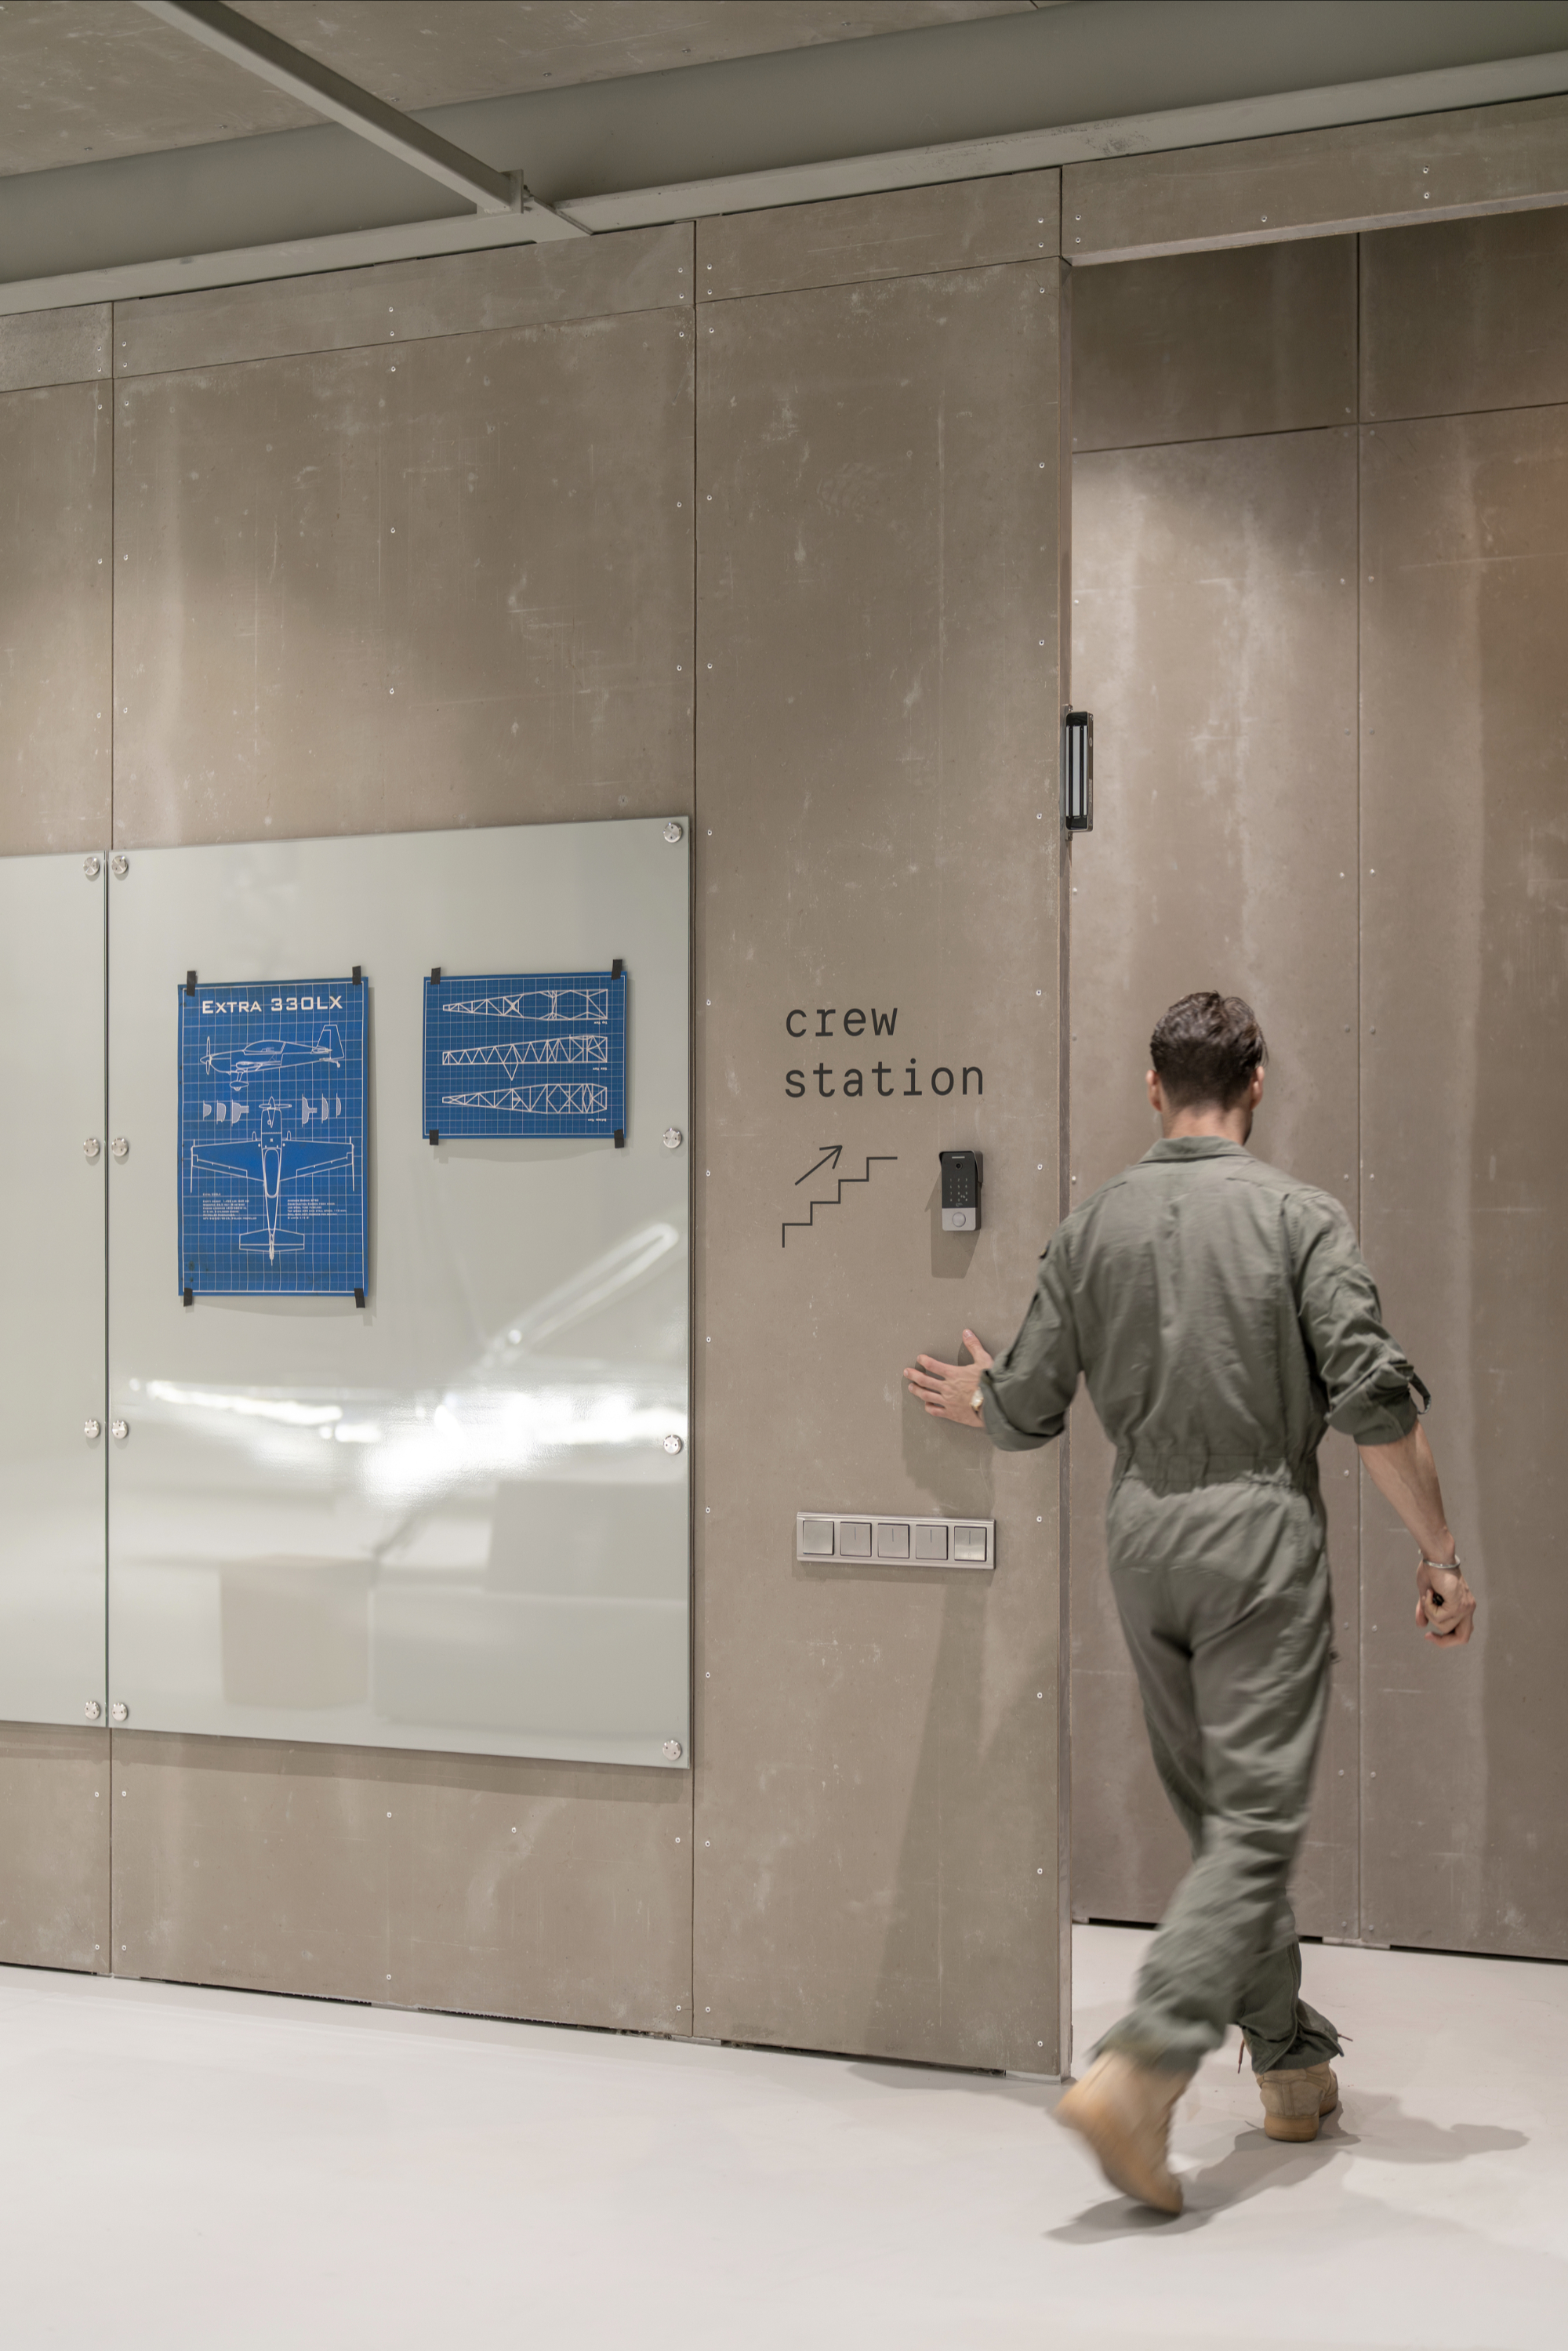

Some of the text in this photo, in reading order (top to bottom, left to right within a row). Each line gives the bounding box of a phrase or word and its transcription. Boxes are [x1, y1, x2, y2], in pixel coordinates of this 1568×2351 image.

[270, 995, 343, 1011] 330LX
[786, 1007, 898, 1038] crew
[785, 1058, 983, 1098] station
